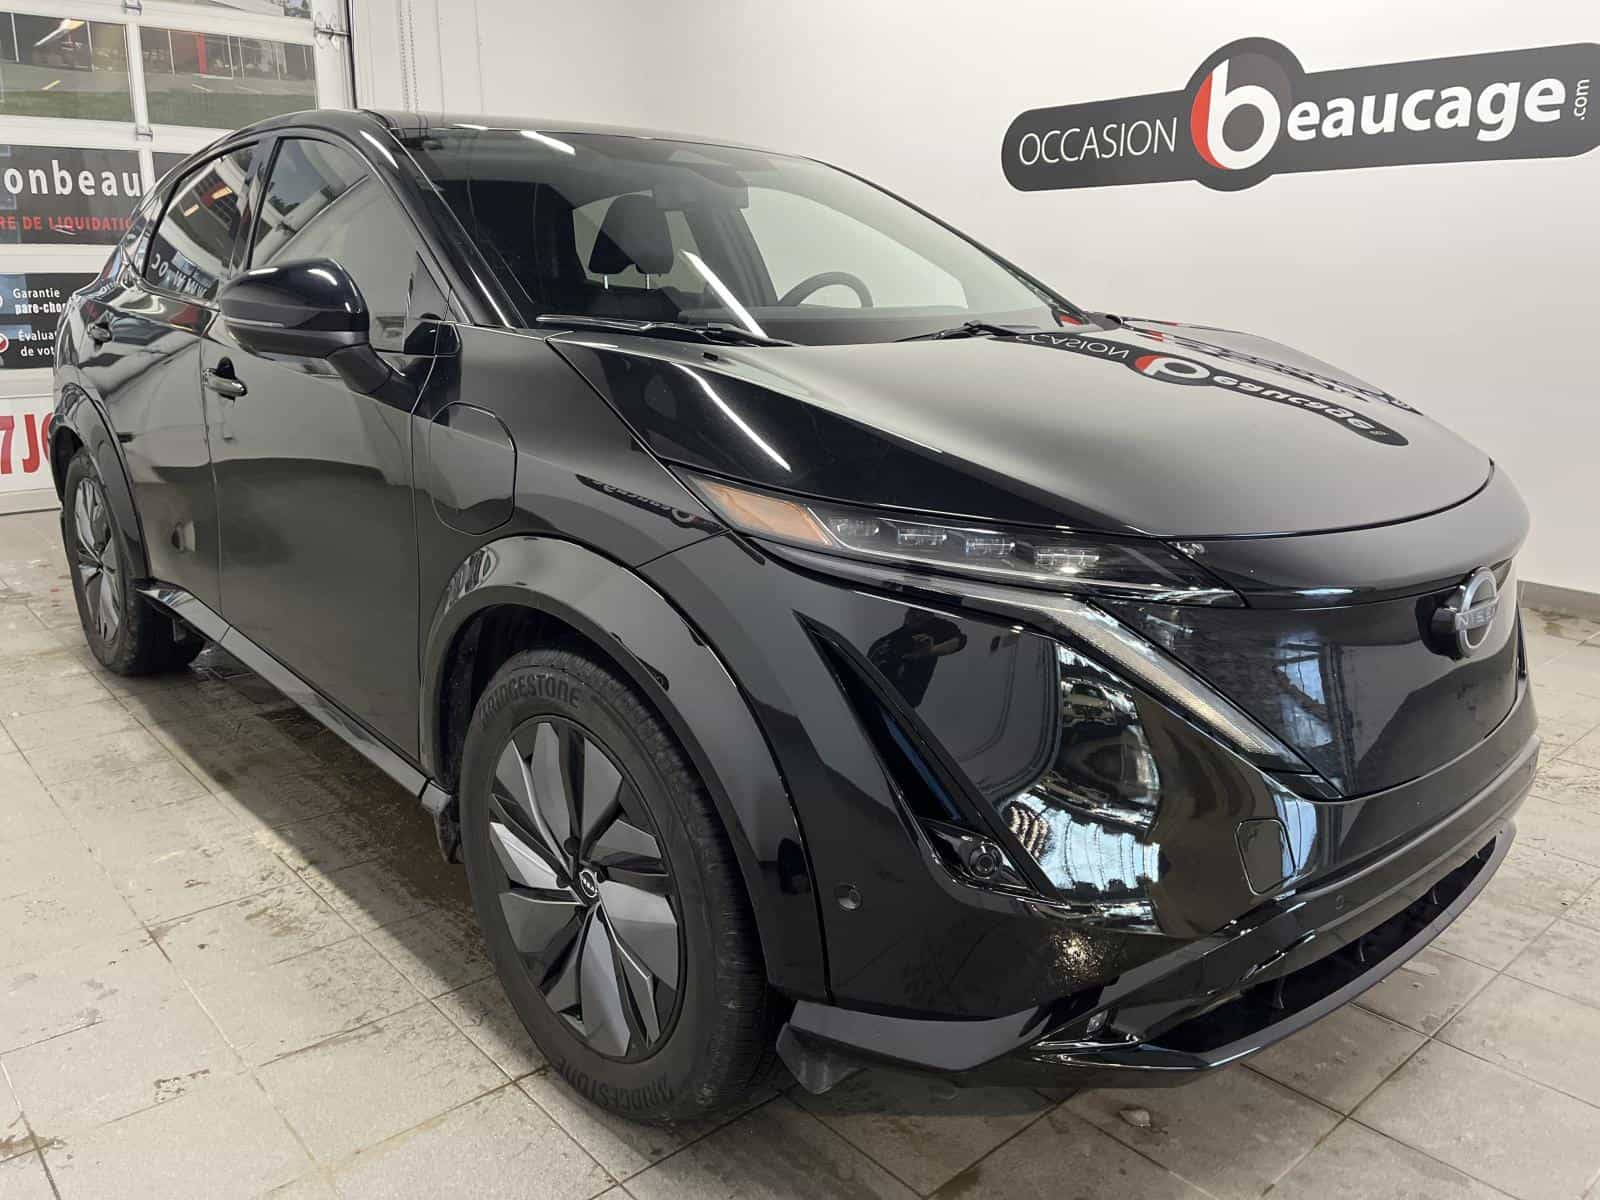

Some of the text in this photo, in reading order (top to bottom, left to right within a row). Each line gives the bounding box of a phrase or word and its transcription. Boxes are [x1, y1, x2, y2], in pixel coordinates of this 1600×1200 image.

[1018, 117, 1178, 166] OCCASION
[3, 159, 142, 197] onbeau
[22, 216, 43, 231] DE
[12, 287, 61, 299] Garantie
[20, 345, 35, 357] de
[480, 673, 580, 729] BRIDGESTONE
